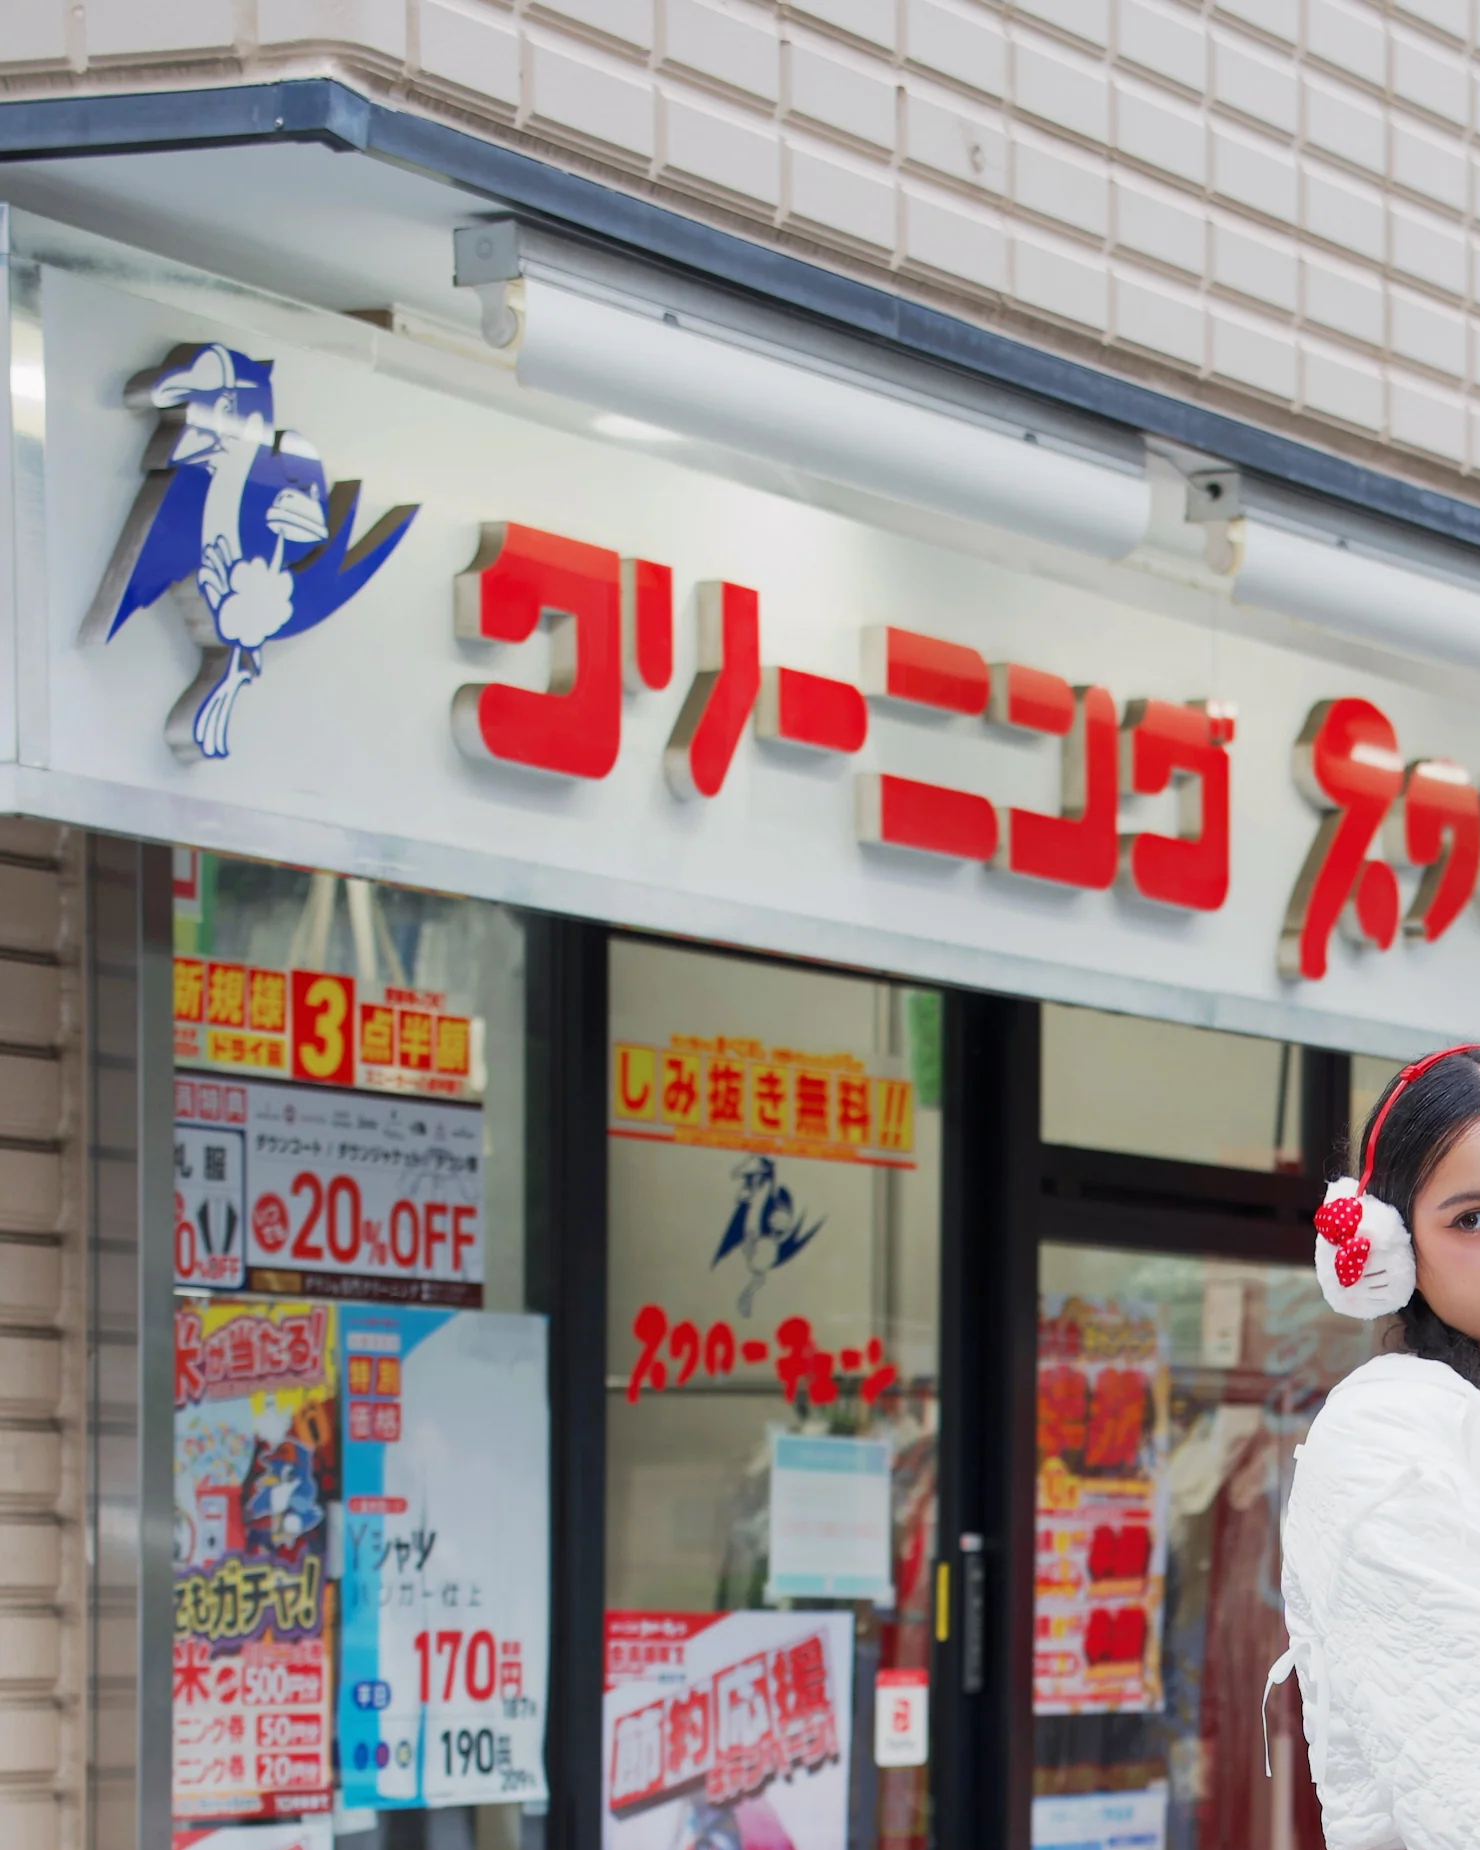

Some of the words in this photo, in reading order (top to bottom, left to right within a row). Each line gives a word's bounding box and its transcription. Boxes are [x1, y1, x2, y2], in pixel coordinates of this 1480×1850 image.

[468, 522, 1236, 913] クリーニング
